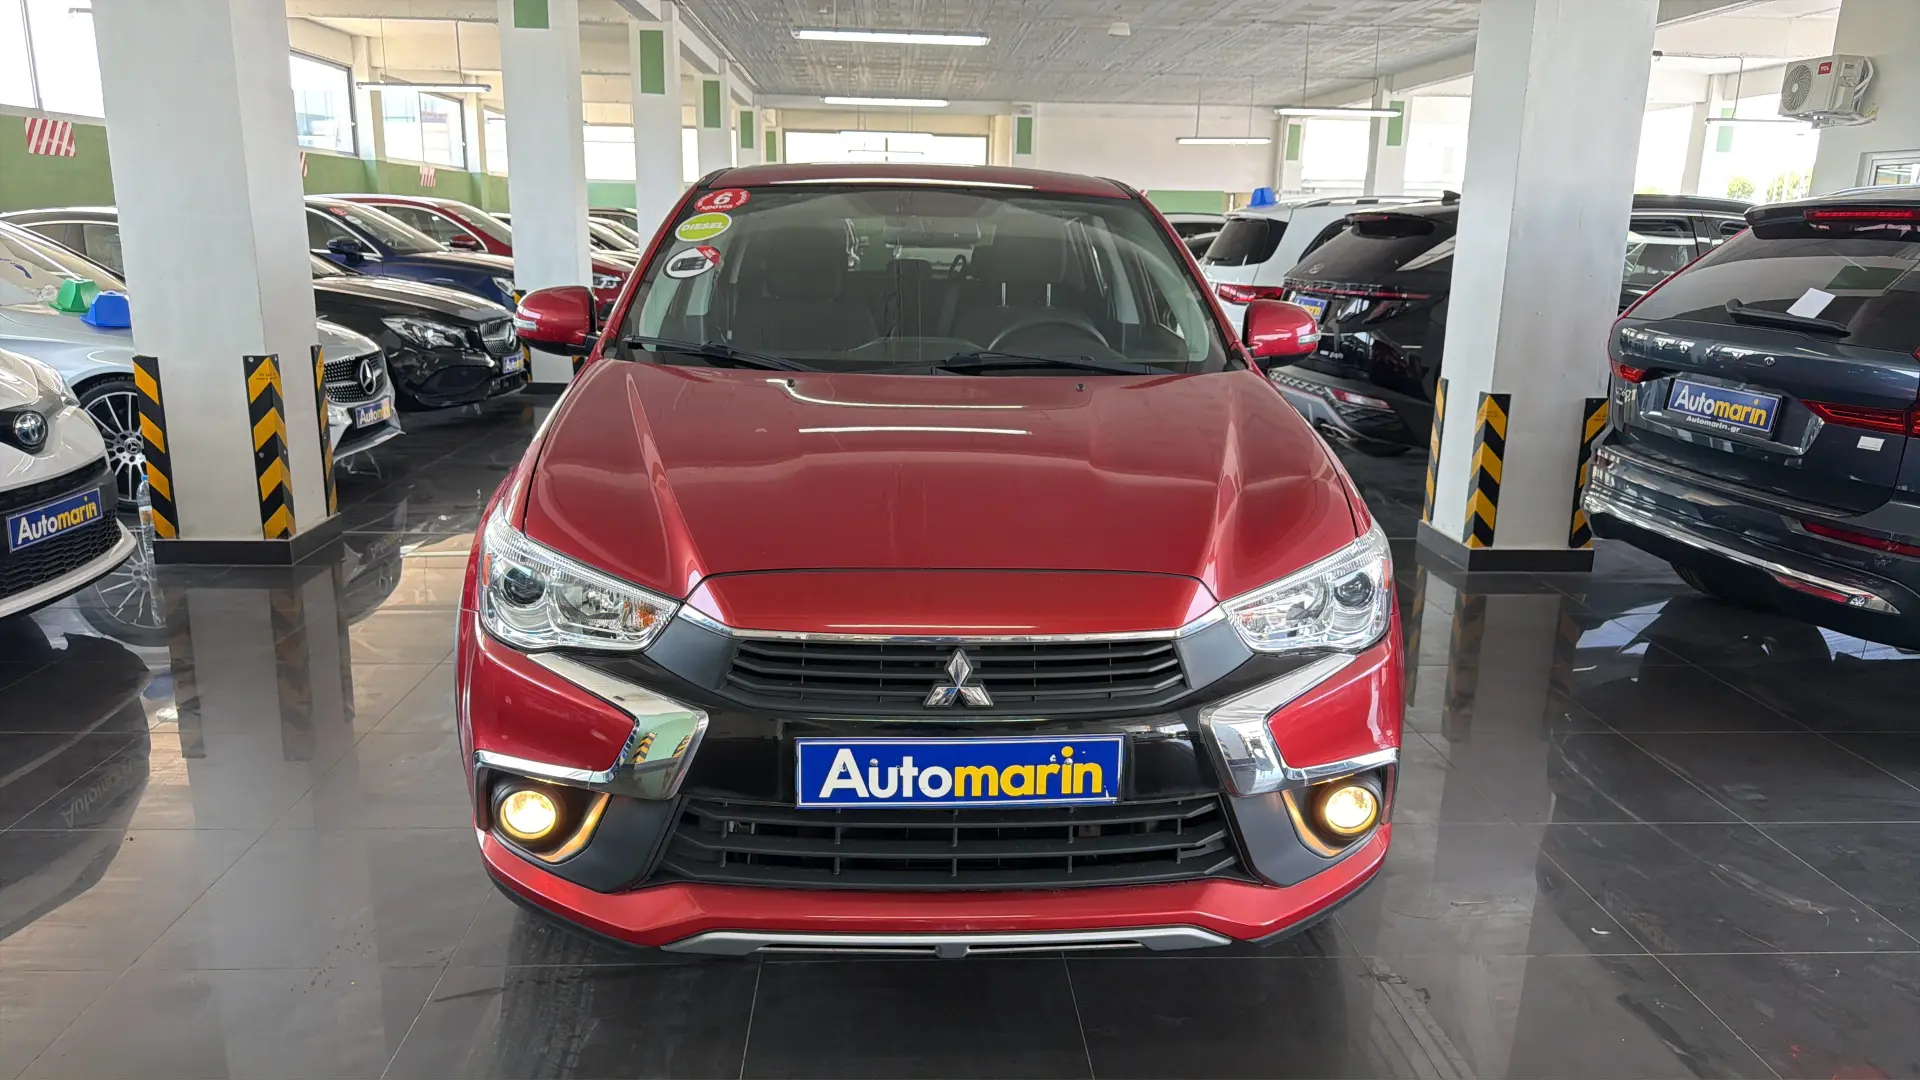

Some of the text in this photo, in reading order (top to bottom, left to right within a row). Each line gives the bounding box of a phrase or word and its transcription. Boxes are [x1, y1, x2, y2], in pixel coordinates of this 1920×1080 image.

[713, 192, 733, 205] 6
[681, 222, 724, 231] DIESEL
[1674, 385, 1767, 426] Automarin
[1686, 415, 1741, 433] Automarin.gr
[17, 496, 98, 545] Automarin
[818, 746, 1102, 798] Automarin
